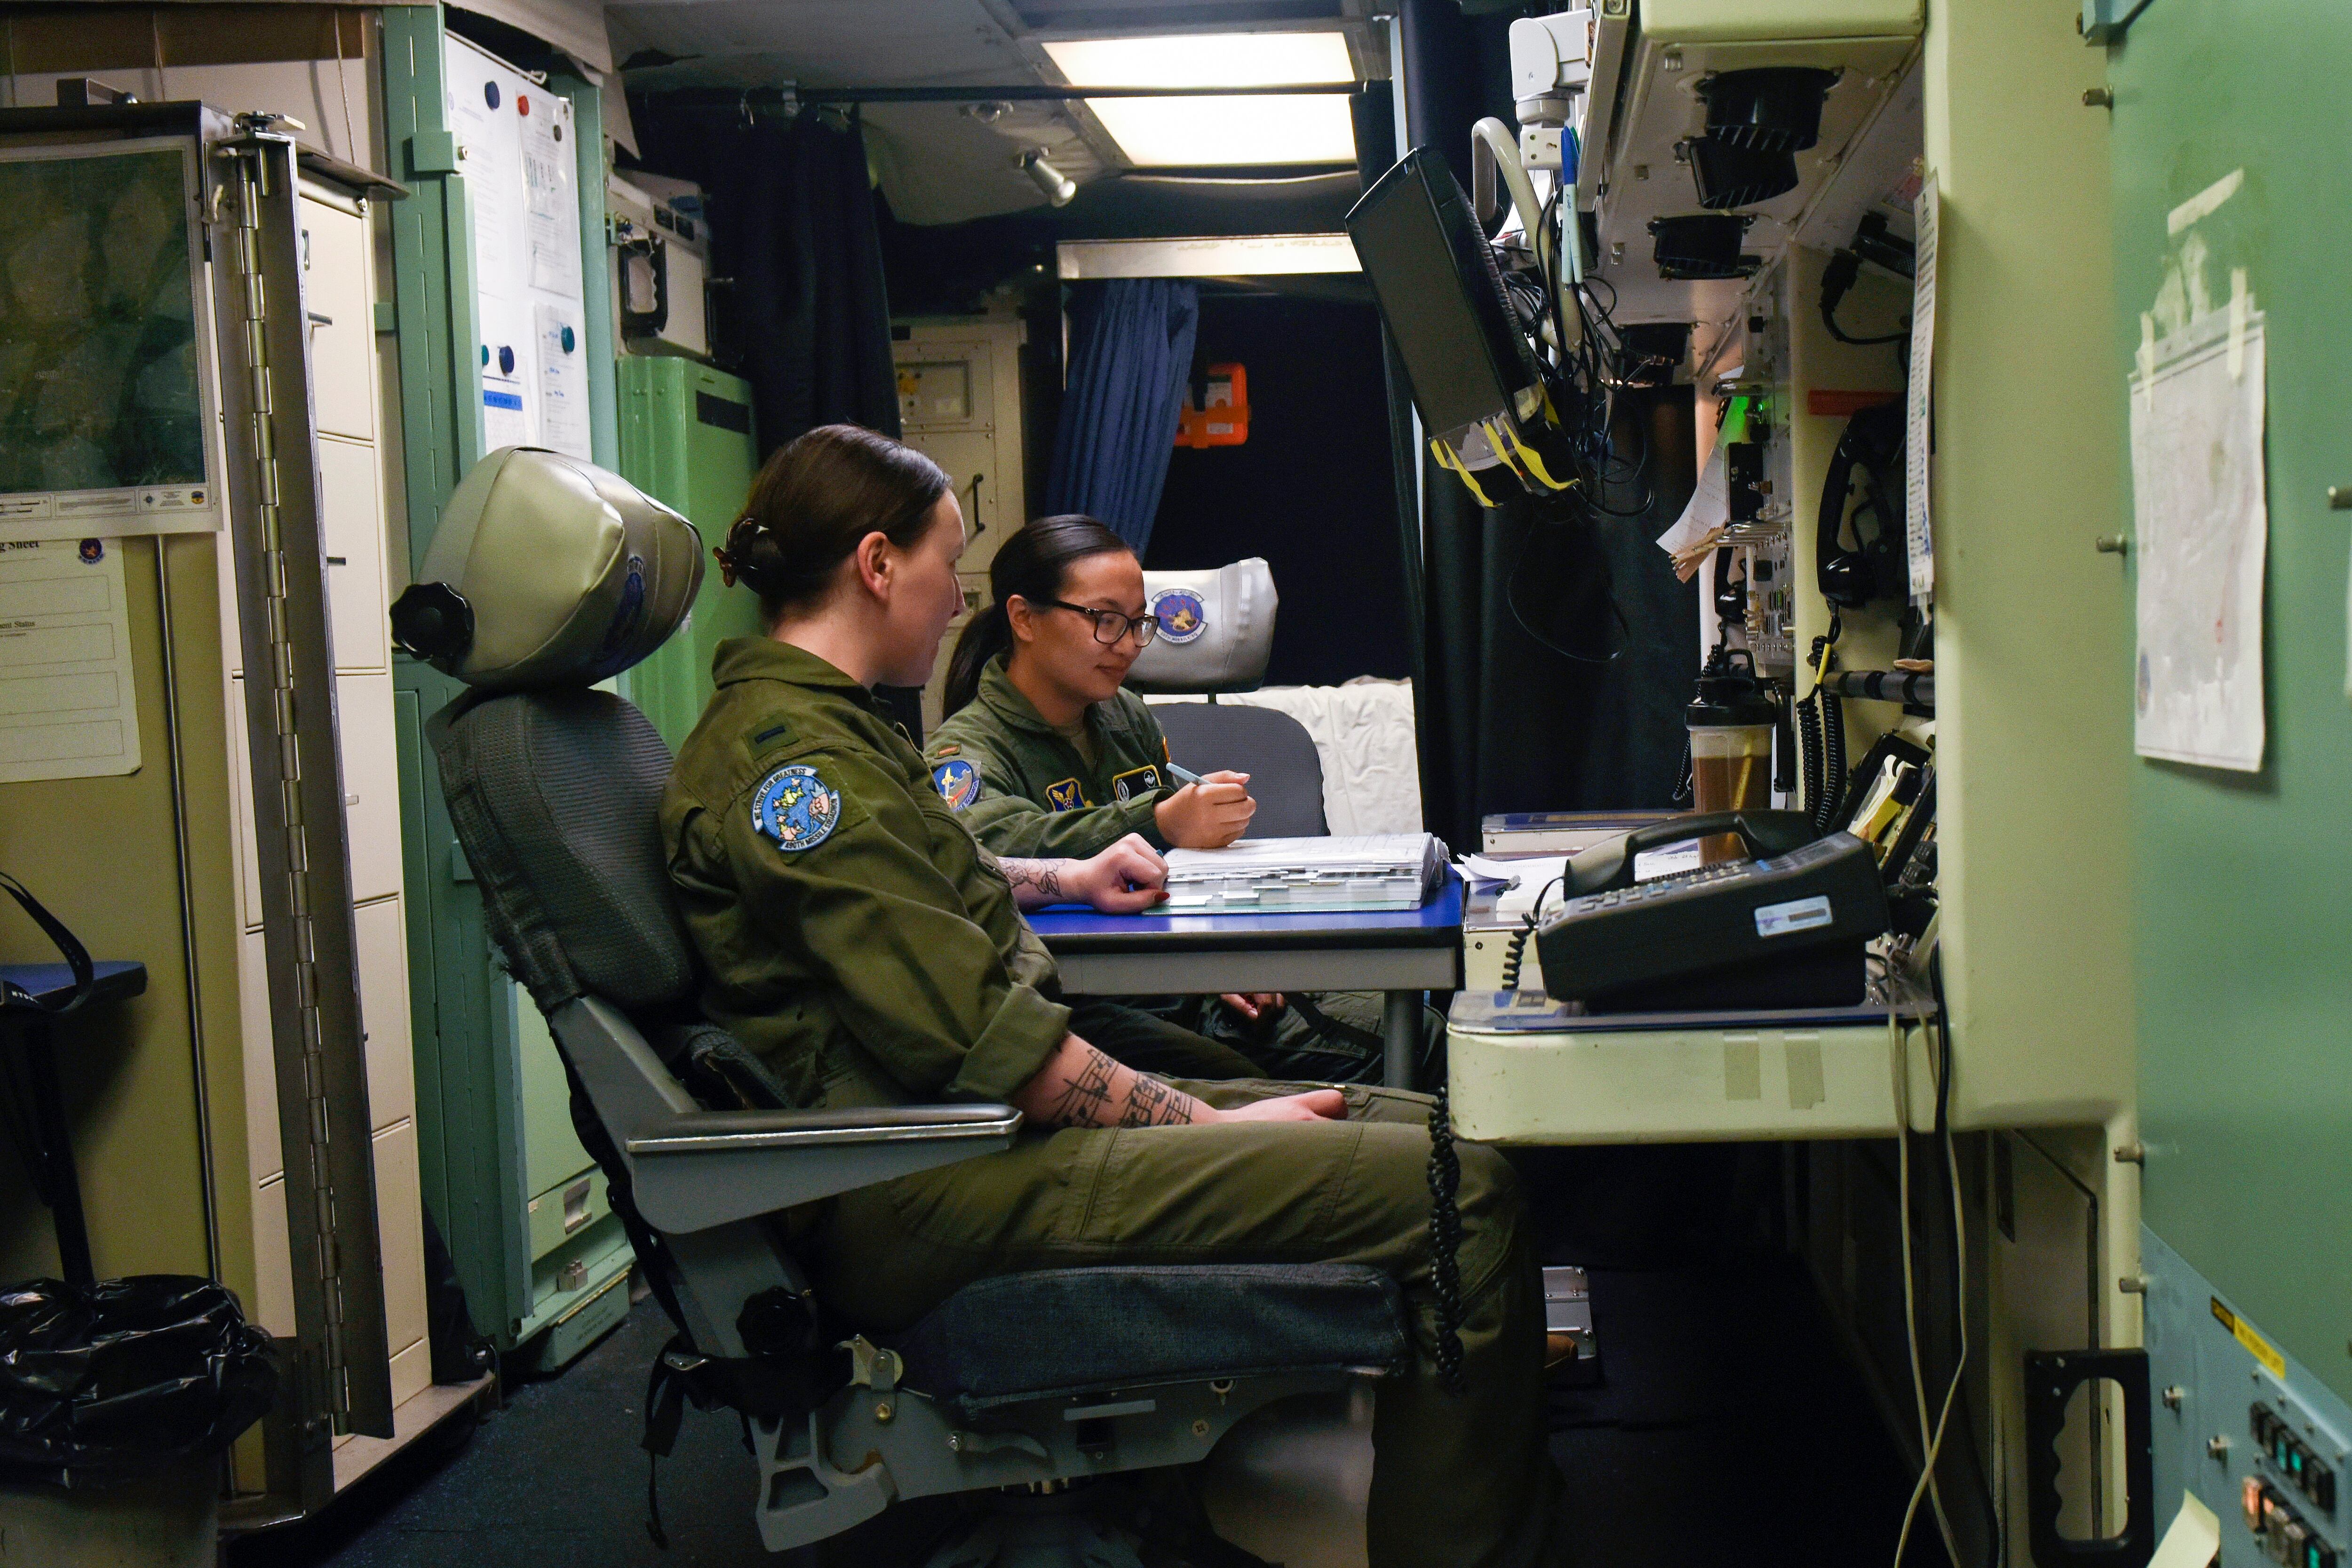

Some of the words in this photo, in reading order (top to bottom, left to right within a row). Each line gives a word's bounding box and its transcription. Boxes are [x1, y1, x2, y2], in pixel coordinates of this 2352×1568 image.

[773, 768, 807, 782] GREATNESS
[763, 780, 774, 791] FOR
[754, 790, 766, 811] STRIVE
[754, 811, 762, 820] WE
[784, 840, 805, 849] 490TH
[805, 827, 828, 846] MISSILE
[825, 798, 838, 828] SQUADRON
